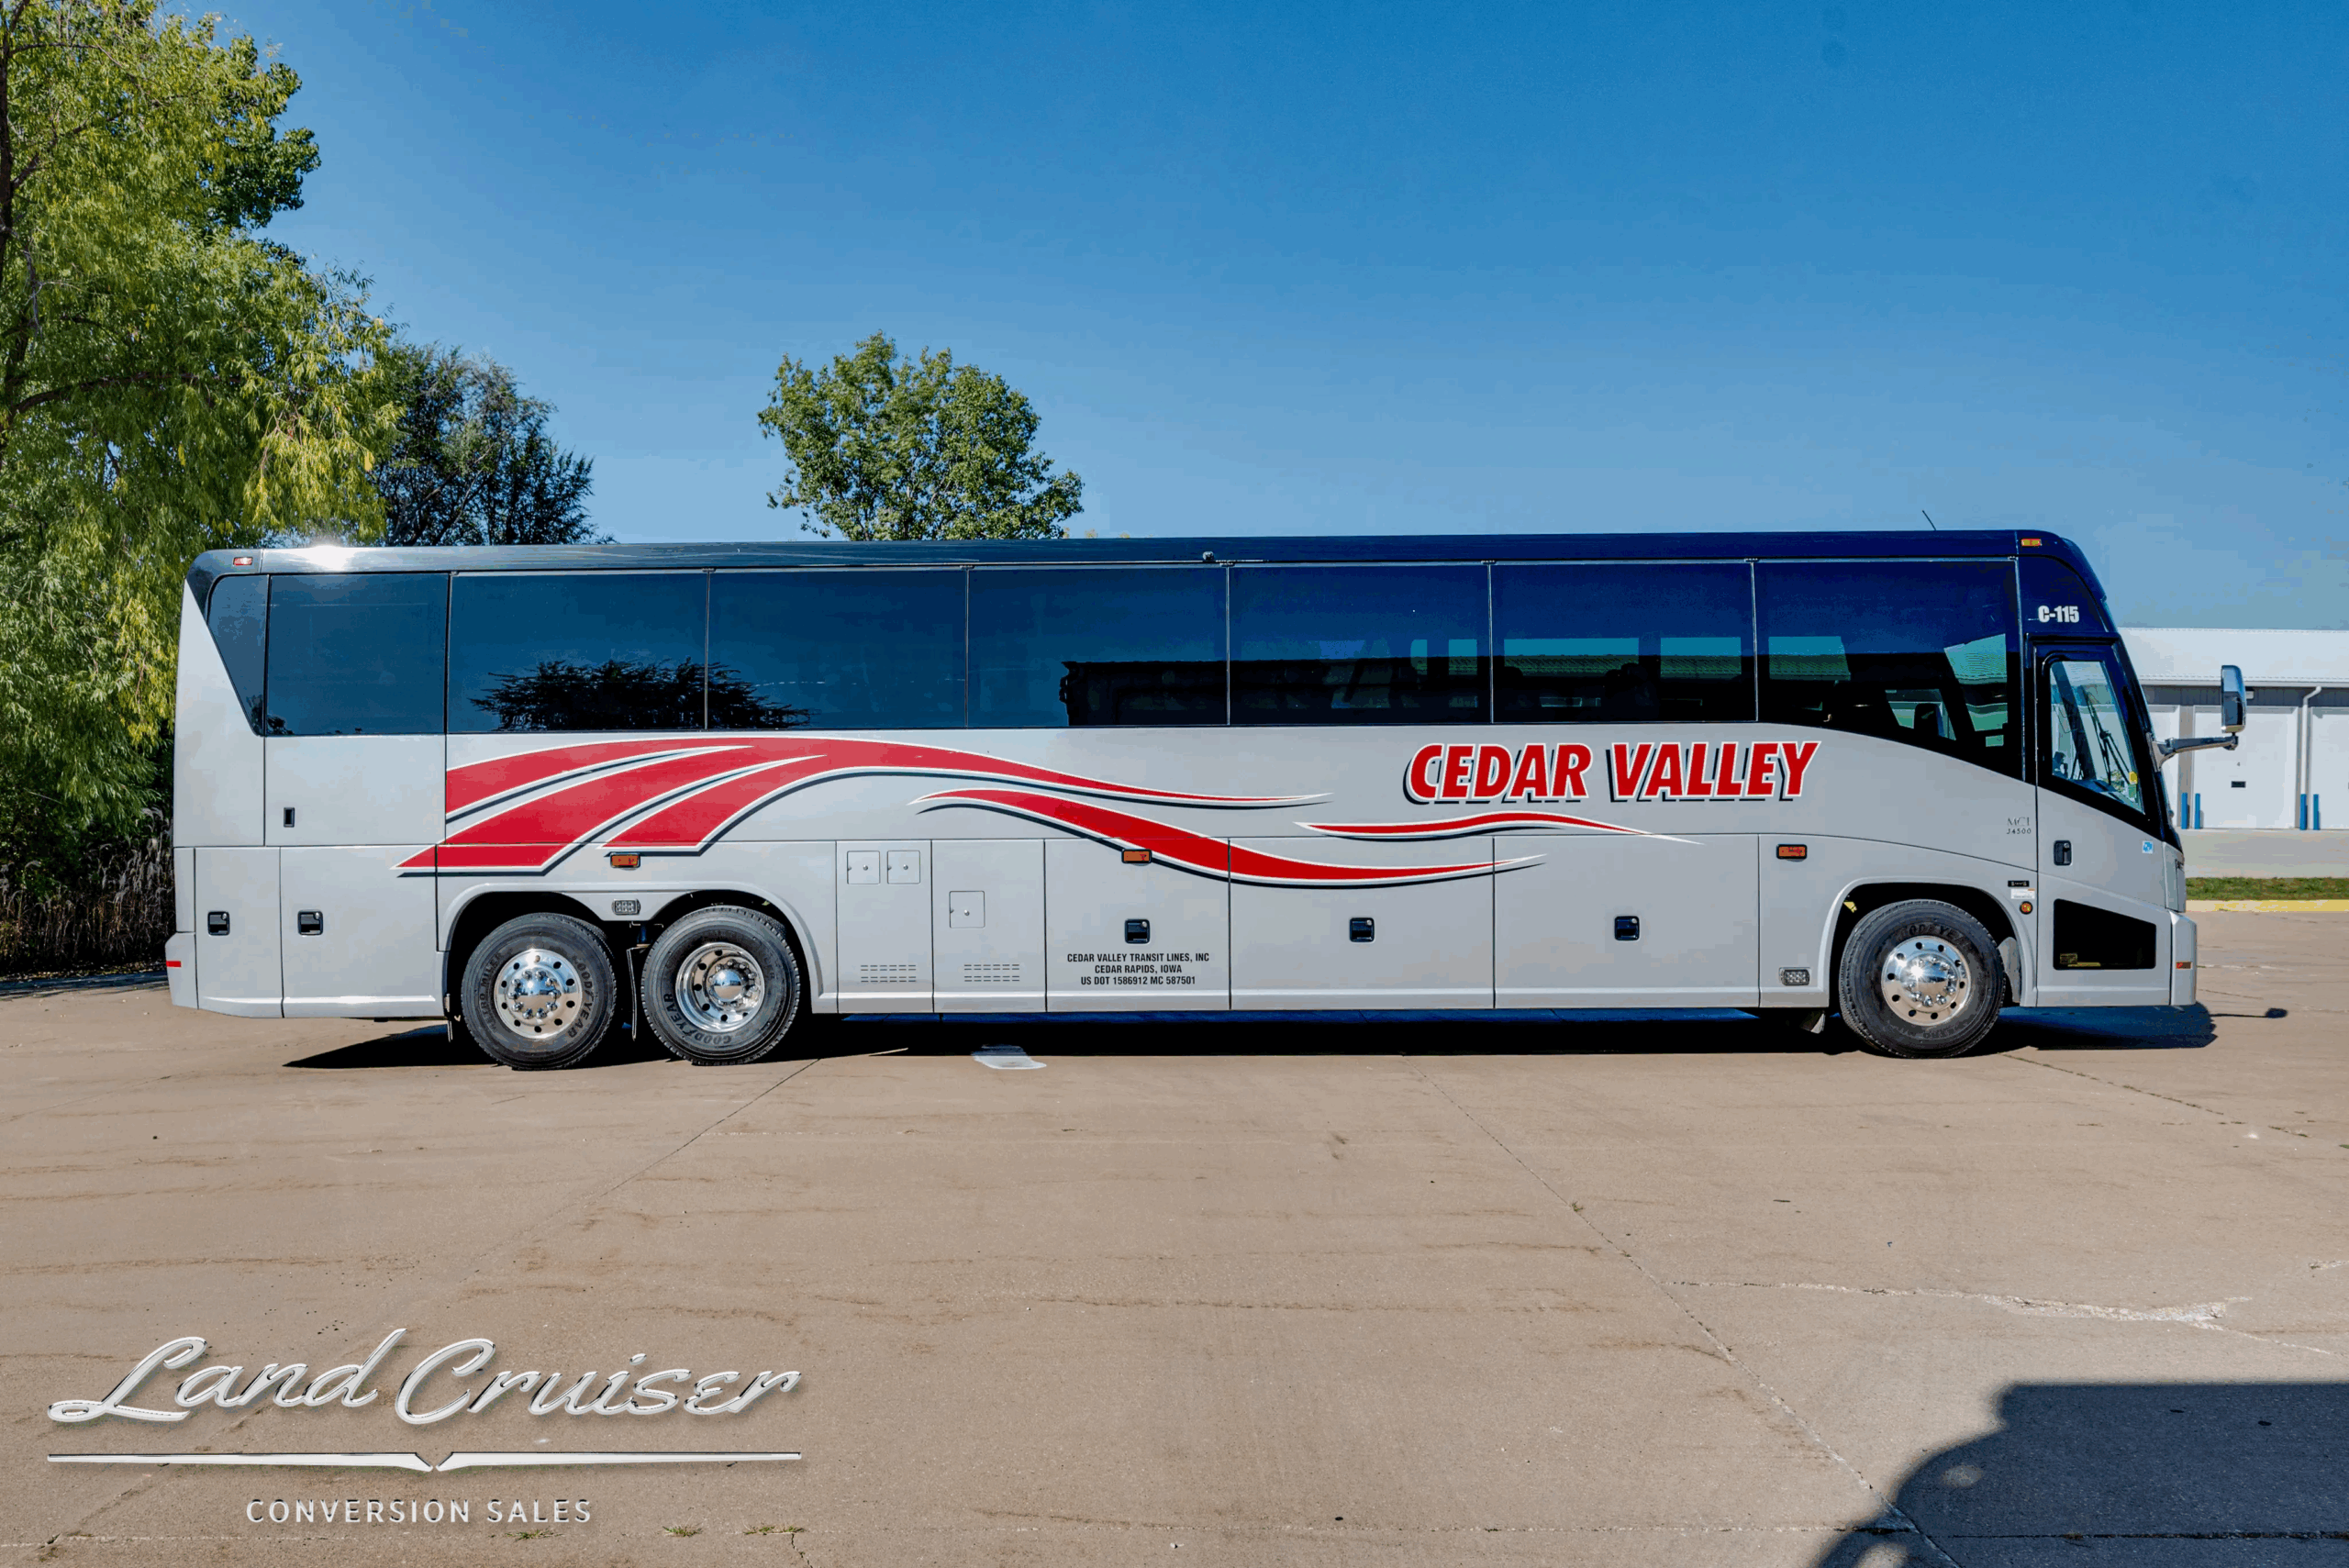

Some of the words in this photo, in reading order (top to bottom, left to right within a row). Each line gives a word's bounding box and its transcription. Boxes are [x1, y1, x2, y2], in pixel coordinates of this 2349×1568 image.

[2038, 605, 2080, 623] C-115
[1404, 742, 1593, 805] CEDAR
[1606, 740, 1822, 803] VALLEY
[2007, 817, 2031, 827] MCI
[1067, 953, 1095, 962] CEDAR
[1097, 953, 1127, 962] VALLEY
[1130, 953, 1164, 962] TRANSIT
[1166, 953, 1193, 963] LINES,
[1195, 952, 1209, 962] INC
[1095, 965, 1122, 973] CEDAR
[1124, 965, 1158, 974] RAPIDS,
[1160, 964, 1182, 973] IOWA
[1081, 976, 1092, 984] US
[1094, 976, 1110, 984] DOT
[1113, 976, 1148, 984] 1586912
[1150, 976, 1163, 984] MC
[1165, 976, 1196, 984] 587501
[663, 993, 732, 1044] GOODYEAR
